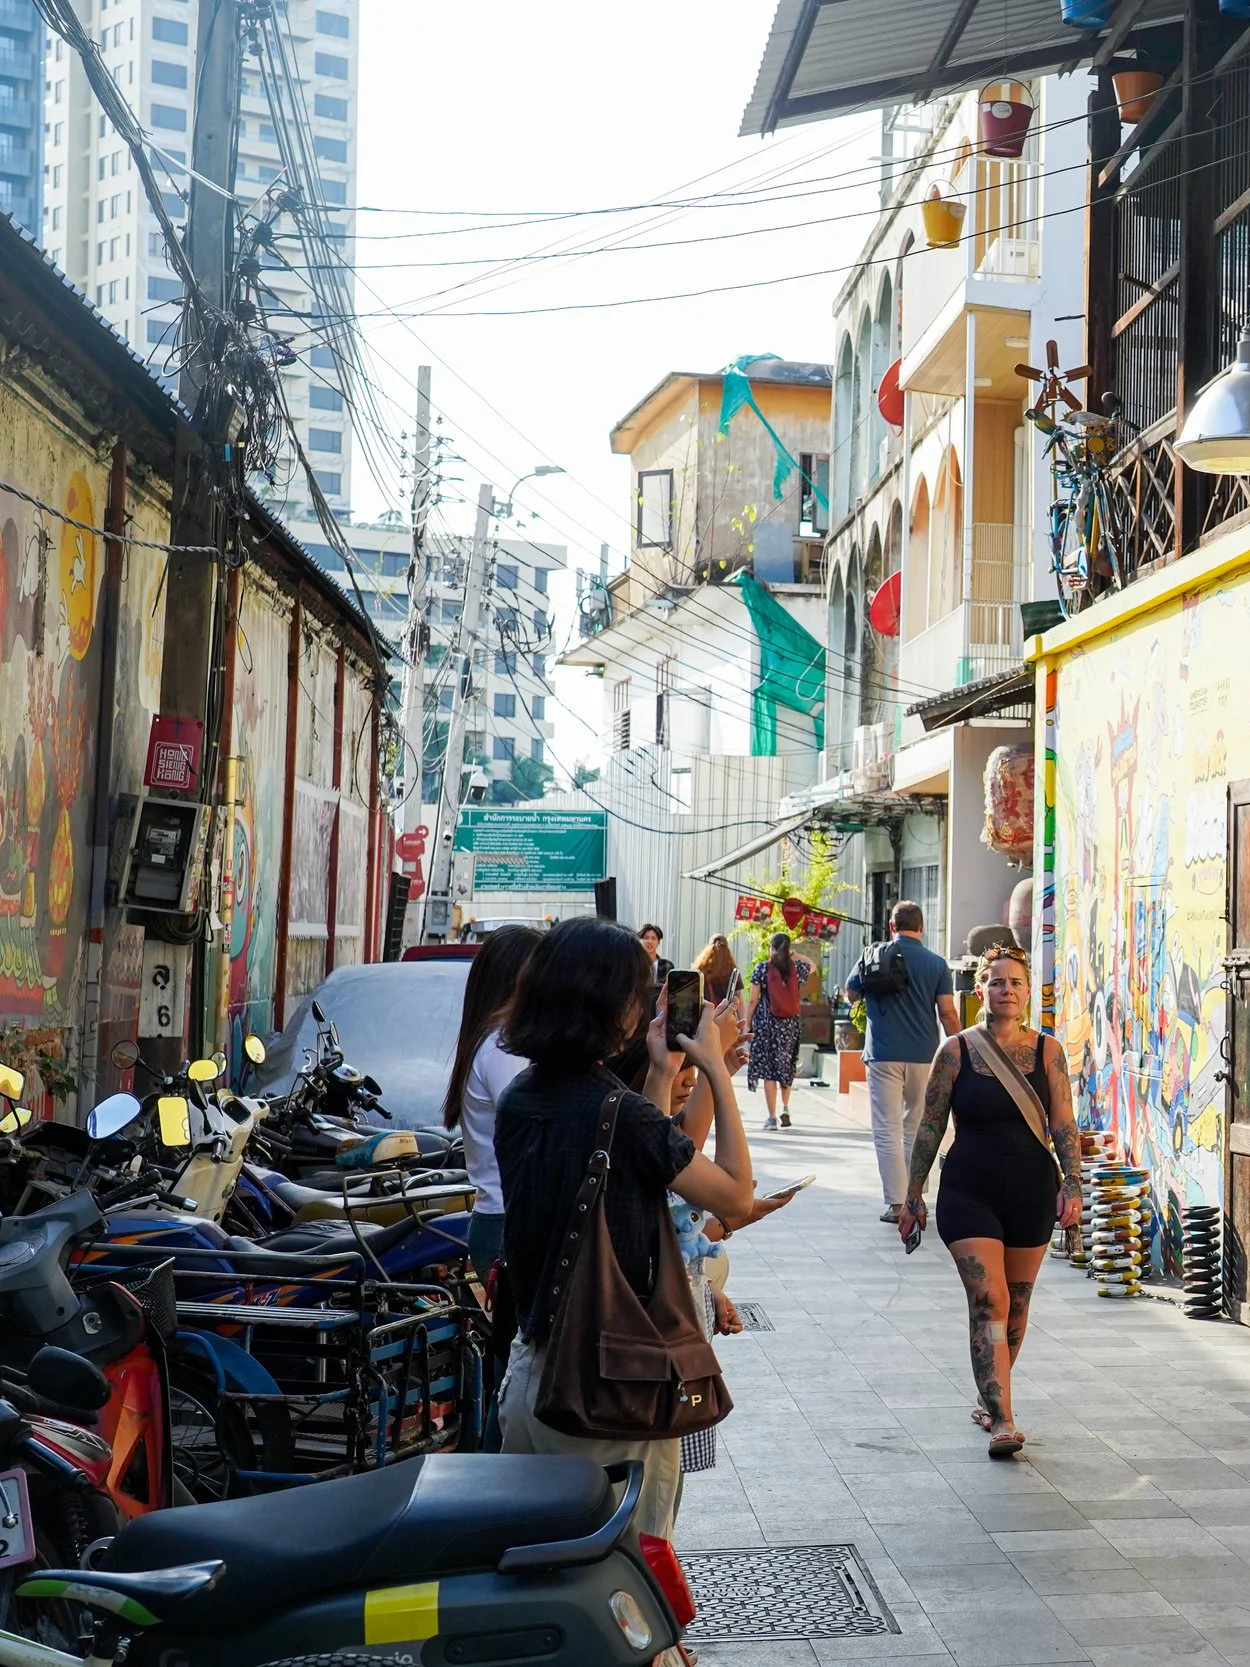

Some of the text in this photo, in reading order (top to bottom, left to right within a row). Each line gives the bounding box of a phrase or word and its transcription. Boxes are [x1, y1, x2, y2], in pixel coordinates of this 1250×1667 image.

[158, 759, 186, 771] SIENG
[156, 768, 185, 782] KONG
[157, 1005, 171, 1027] 6
[691, 1394, 702, 1407] P
